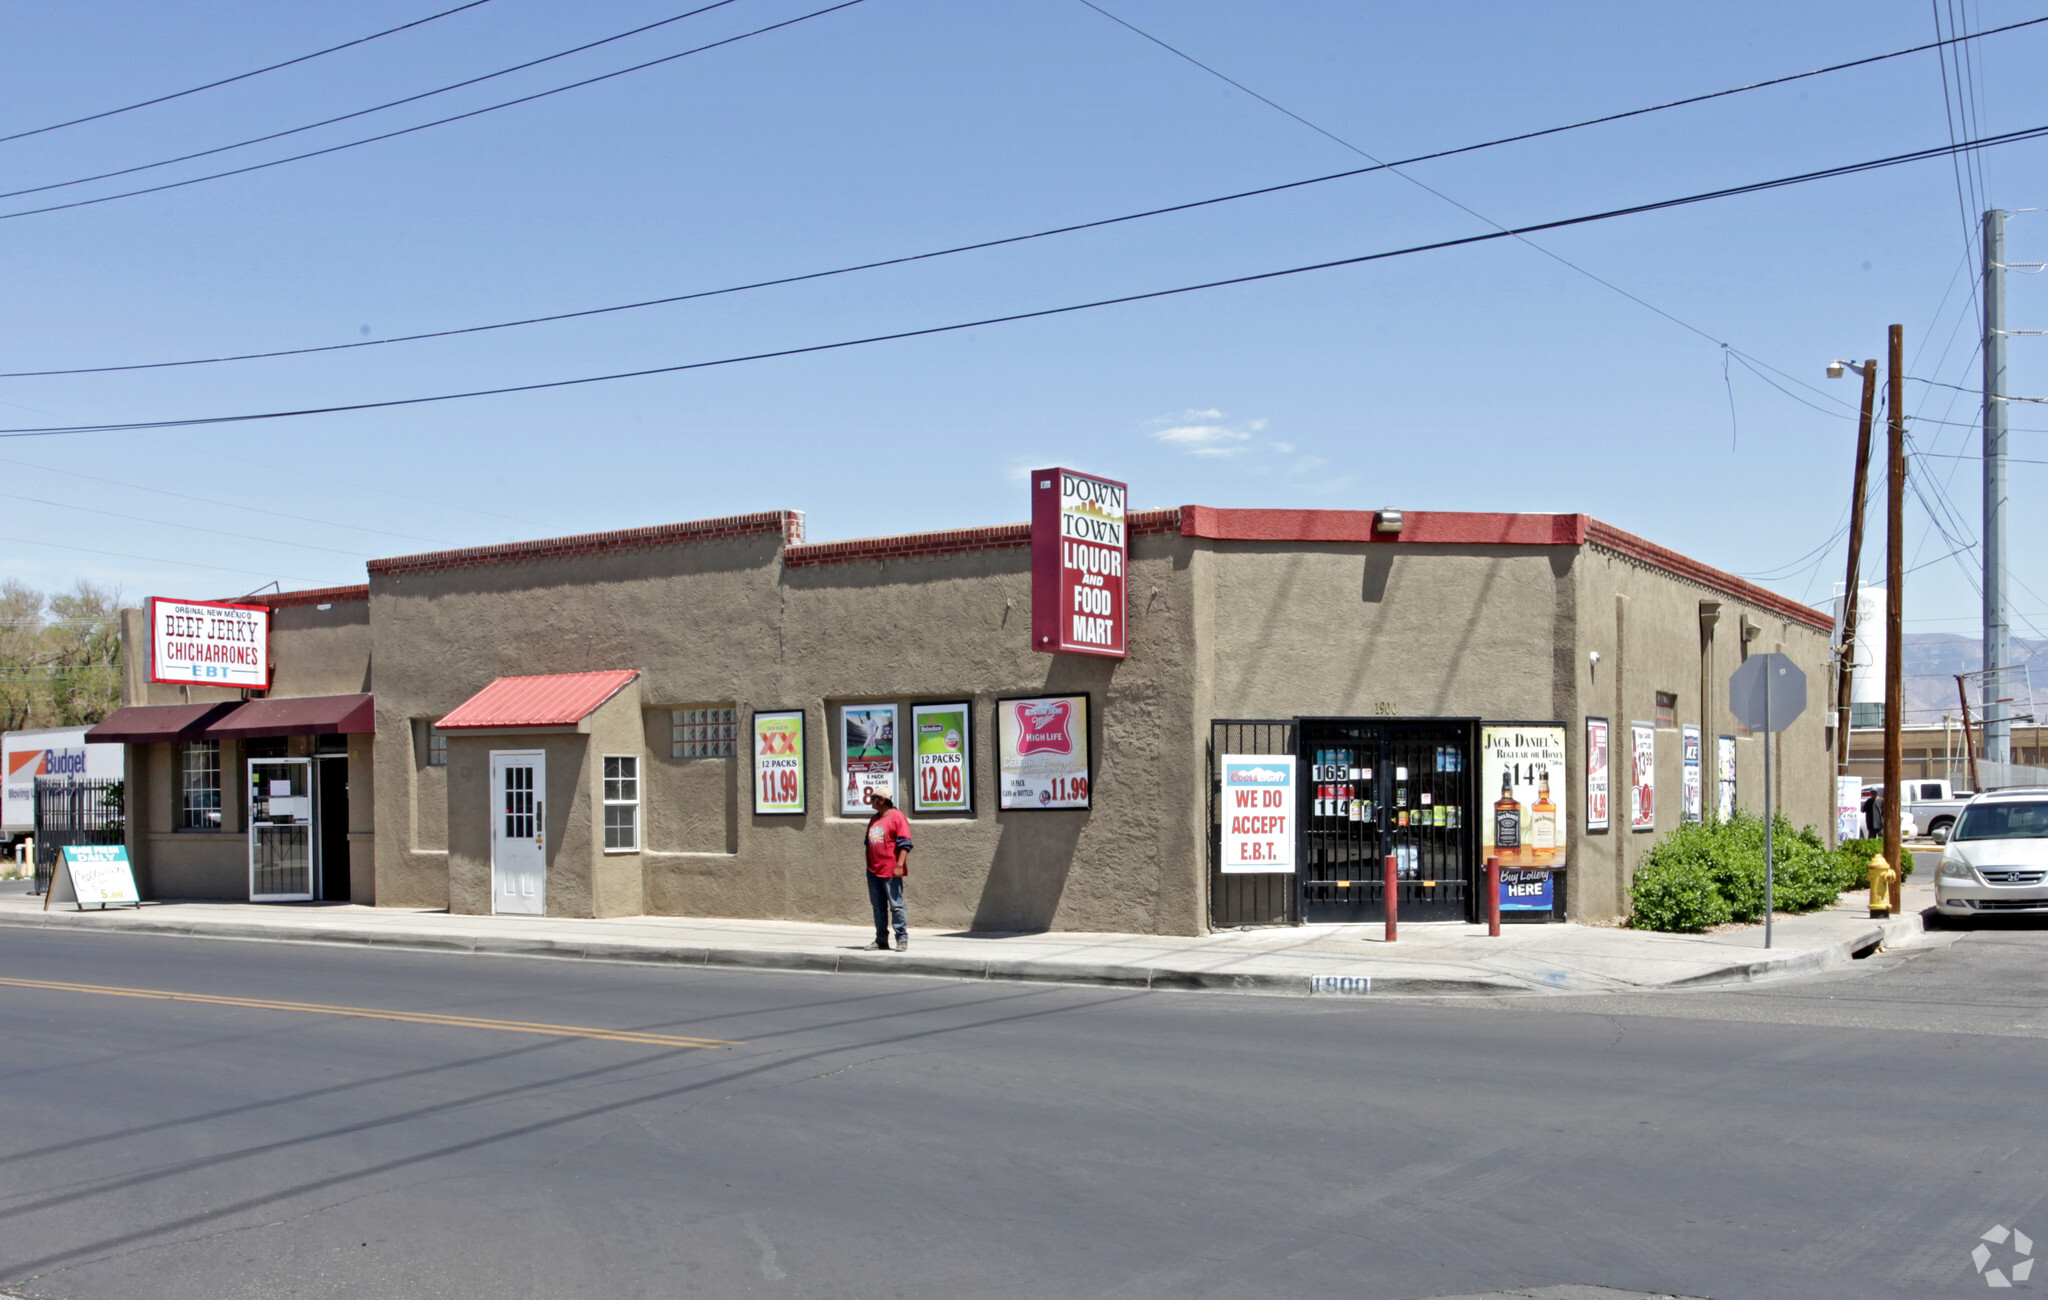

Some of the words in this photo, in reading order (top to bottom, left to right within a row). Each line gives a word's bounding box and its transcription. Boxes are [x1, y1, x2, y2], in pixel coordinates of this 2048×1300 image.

[1063, 475, 1122, 508] DOWN
[1063, 513, 1121, 545] TOWN
[1064, 541, 1122, 577] LIQUOR
[1082, 573, 1104, 587] AND
[1074, 585, 1112, 616] FOOD
[175, 606, 205, 616] ORGINAL
[207, 609, 223, 617] NEW
[224, 610, 252, 620] MEXICO
[165, 614, 204, 639] BEEF
[207, 618, 259, 643] JERKY
[1073, 614, 1114, 646] MART
[167, 641, 258, 666] CHICHARRONES
[192, 665, 230, 678] EBT
[1374, 701, 1398, 715] 1900
[1031, 714, 1056, 730] Miller
[759, 731, 798, 756] XX
[1026, 733, 1045, 742] HIGH
[1046, 732, 1063, 741] LIFE
[1484, 733, 1511, 750] JACK
[1515, 733, 1560, 748] DANIEL'S
[921, 755, 930, 764] 12
[932, 754, 961, 764] PACKS
[1496, 749, 1529, 759] REGULAR
[1542, 749, 1564, 759] HONEY
[1685, 746, 1698, 760] ICE
[45, 747, 86, 780] Budget
[761, 760, 770, 768] 12
[771, 759, 797, 768] PACKS
[921, 765, 962, 802] 12.99
[1230, 770, 1258, 782] Coors
[8, 788, 33, 801] Moving
[762, 769, 798, 803] 11.99
[1051, 776, 1088, 801] 11.99
[1235, 789, 1258, 808] WE
[1262, 789, 1282, 808] DO
[1231, 815, 1286, 835] ACCEPT
[77, 853, 115, 862] DAILY
[1240, 842, 1277, 861] E.B.T.
[1500, 870, 1519, 885] Buy
[1508, 883, 1543, 897] HERE
[1314, 976, 1368, 995] 1900
